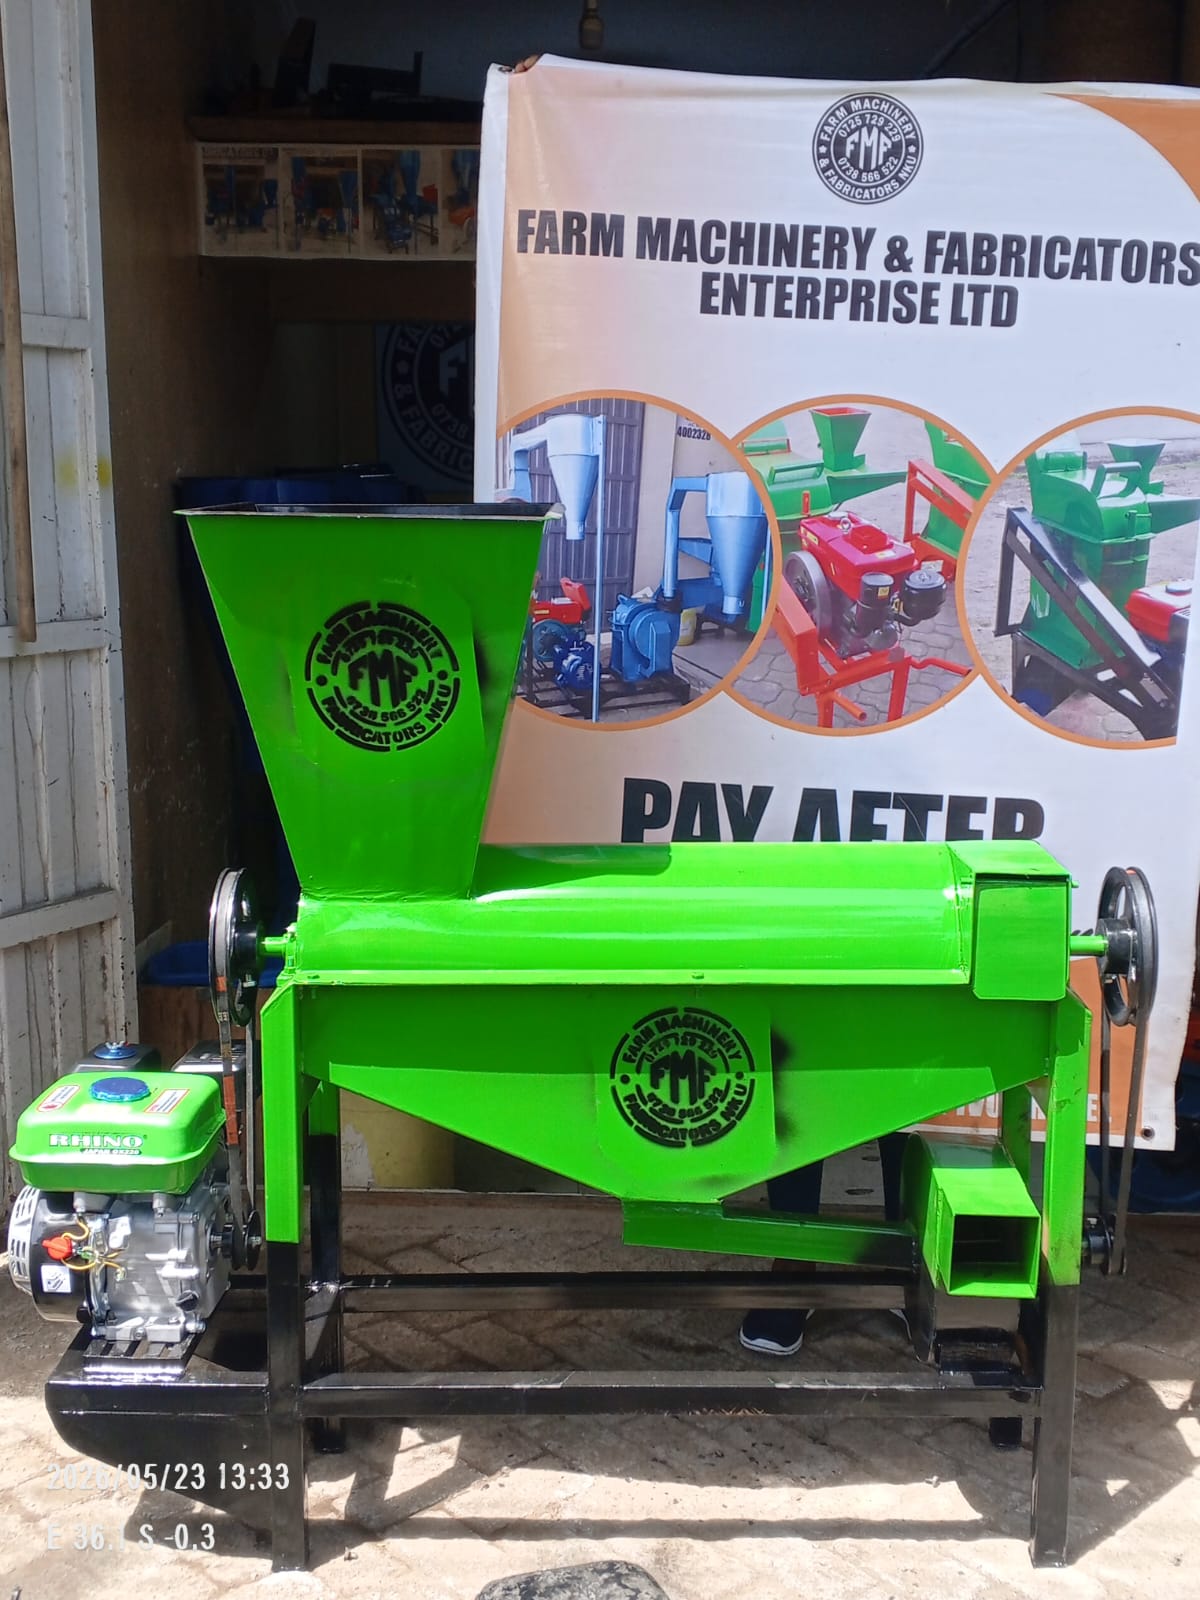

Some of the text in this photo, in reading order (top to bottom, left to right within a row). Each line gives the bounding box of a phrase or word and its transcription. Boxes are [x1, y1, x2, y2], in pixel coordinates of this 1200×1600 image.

[820, 98, 916, 141] FARM MACHINERY
[838, 114, 901, 142] 0725 729 229
[838, 156, 898, 182] 0738 566 522
[845, 126, 892, 170] FMF
[819, 155, 916, 199] & FABRICATORS NKU
[517, 209, 1200, 286] FARM MACHINERY & FABRICATORS
[700, 271, 1019, 328] ENTERPRISE LTD
[400, 405, 474, 473] FABRIC
[348, 649, 418, 708] FMF
[425, 684, 451, 723] NKU
[621, 777, 773, 842] PAY
[622, 1025, 656, 1063] FARM
[651, 1050, 716, 1105] FMF
[720, 1084, 747, 1121] NKU
[49, 1134, 143, 1147] RHINO
